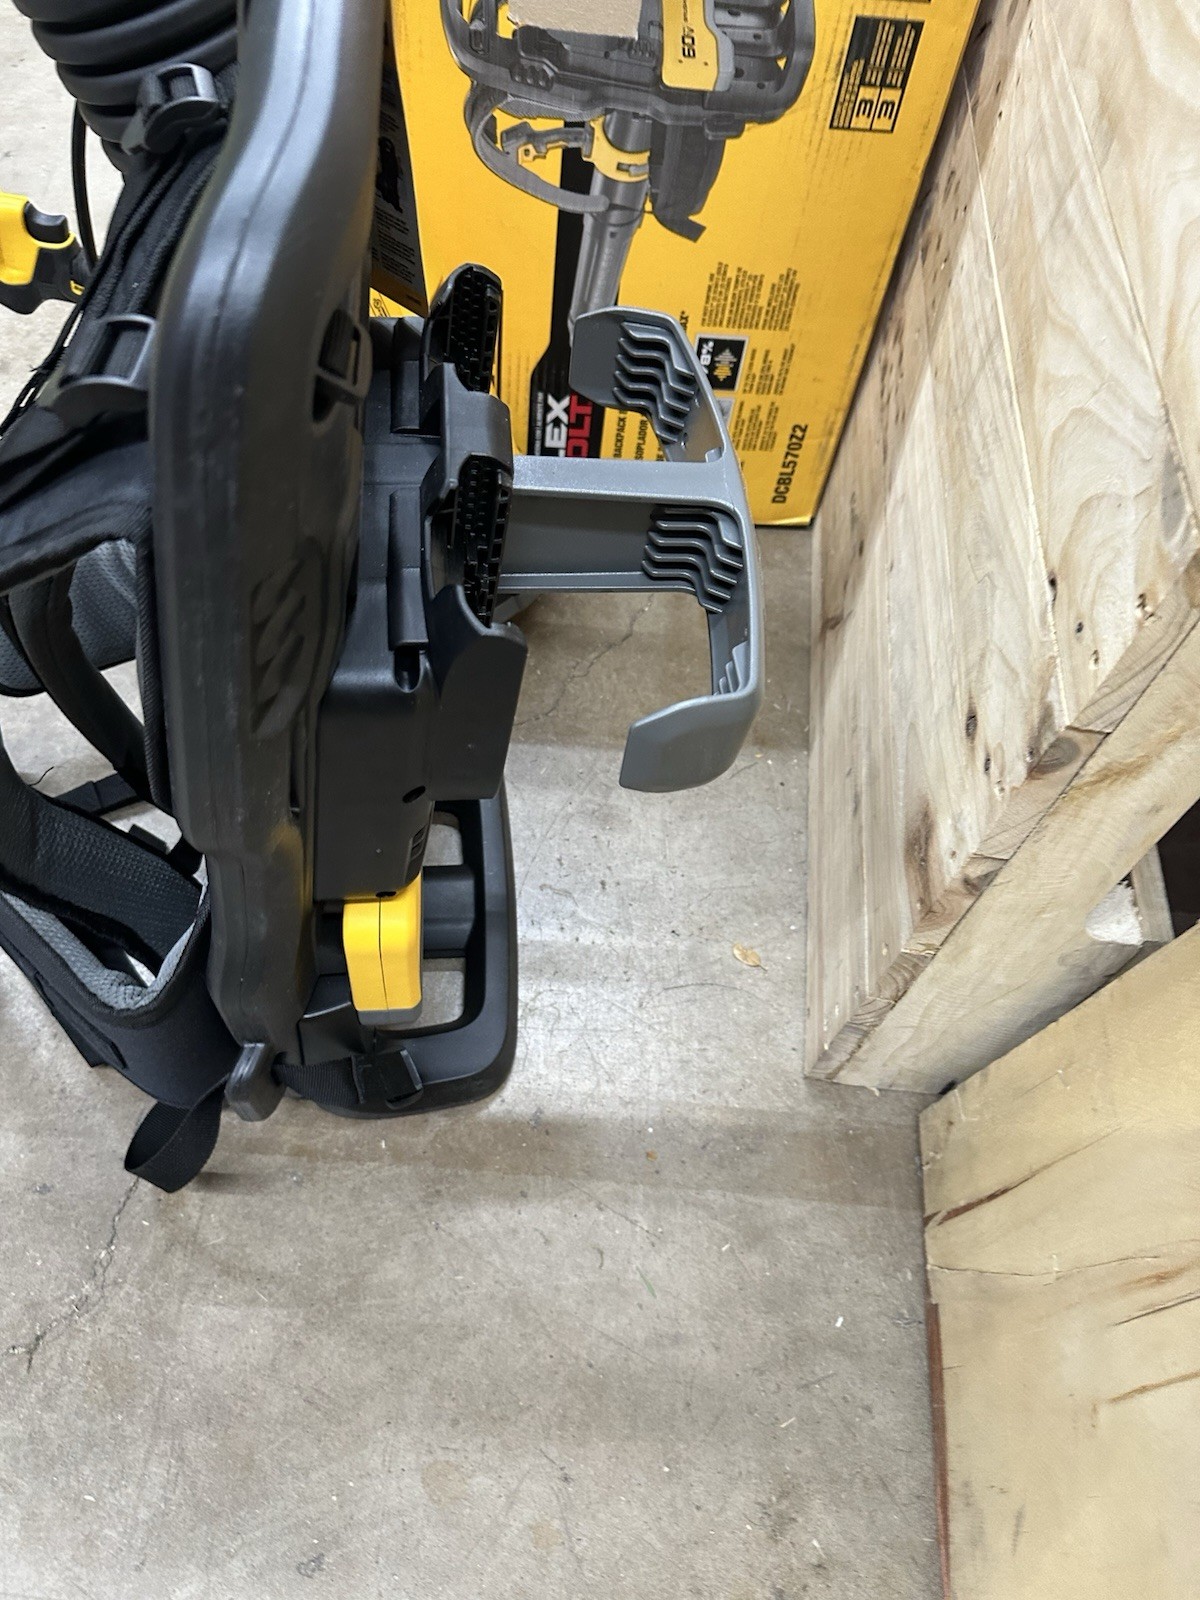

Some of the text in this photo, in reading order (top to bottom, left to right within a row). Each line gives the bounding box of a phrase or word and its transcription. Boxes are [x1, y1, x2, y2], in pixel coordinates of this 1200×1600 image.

[613, 417, 627, 458] BACKPACK
[634, 419, 649, 460] SOPLADOR
[771, 423, 808, 504] DCBL570Z2
